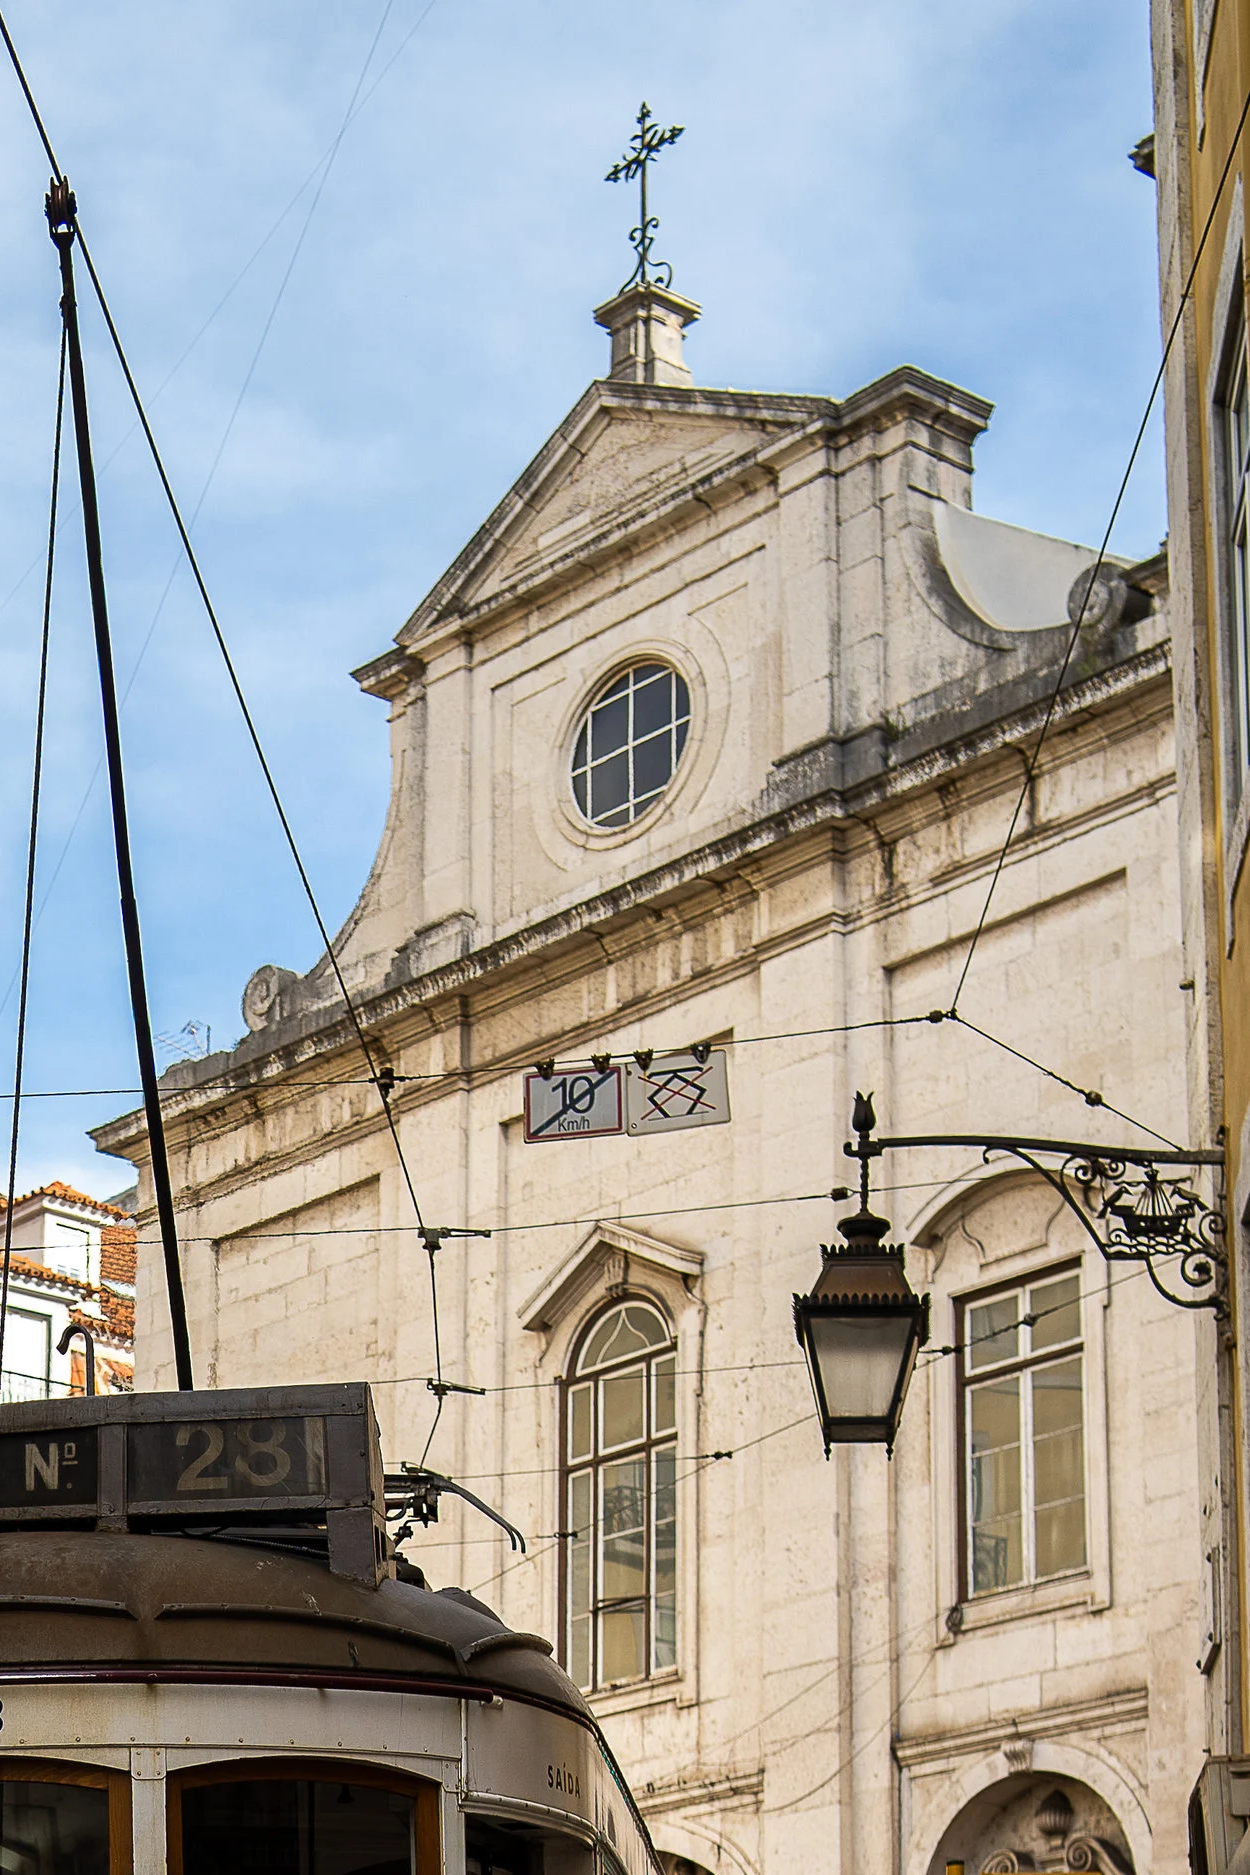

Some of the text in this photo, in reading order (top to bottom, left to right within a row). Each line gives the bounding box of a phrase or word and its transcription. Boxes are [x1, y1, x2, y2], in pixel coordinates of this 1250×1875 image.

[552, 1076, 595, 1114] 10
[558, 1116, 590, 1132] Km/h
[176, 1419, 291, 1491] 28
[547, 1761, 581, 1800] SAÍDA
